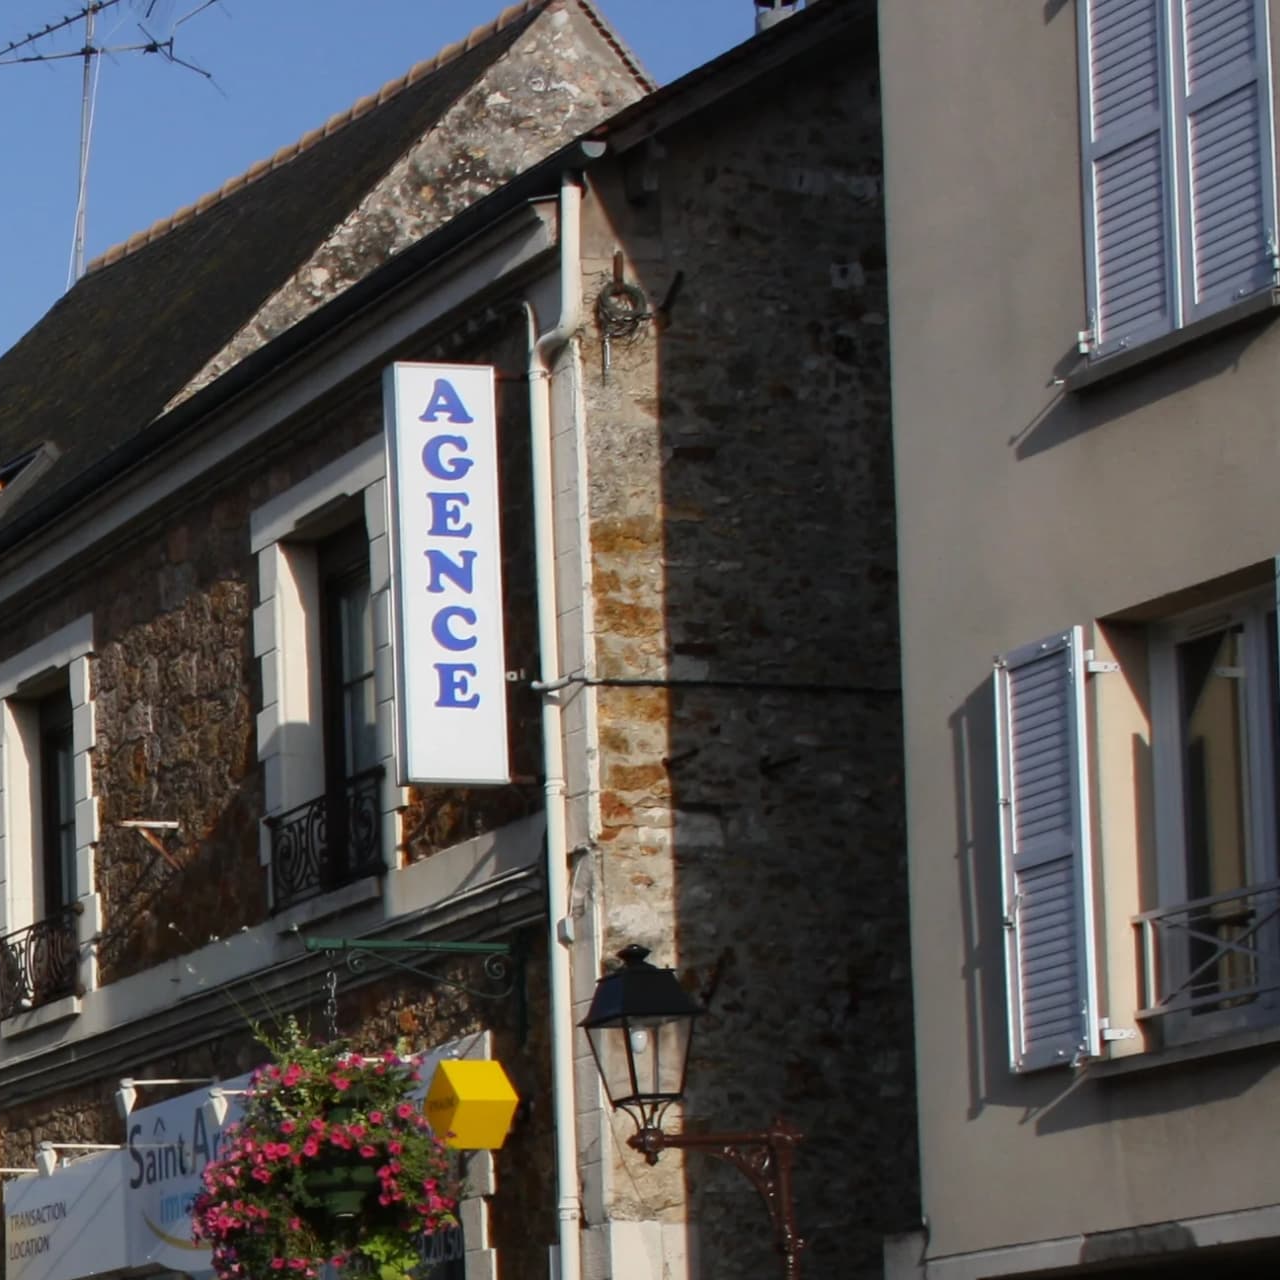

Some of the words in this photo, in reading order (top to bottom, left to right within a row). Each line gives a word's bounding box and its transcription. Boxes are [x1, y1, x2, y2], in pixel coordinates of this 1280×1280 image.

[419, 378, 481, 710] AGENCE
[10, 1201, 67, 1233] TRANSACTION
[9, 1235, 50, 1261] LOCATION
